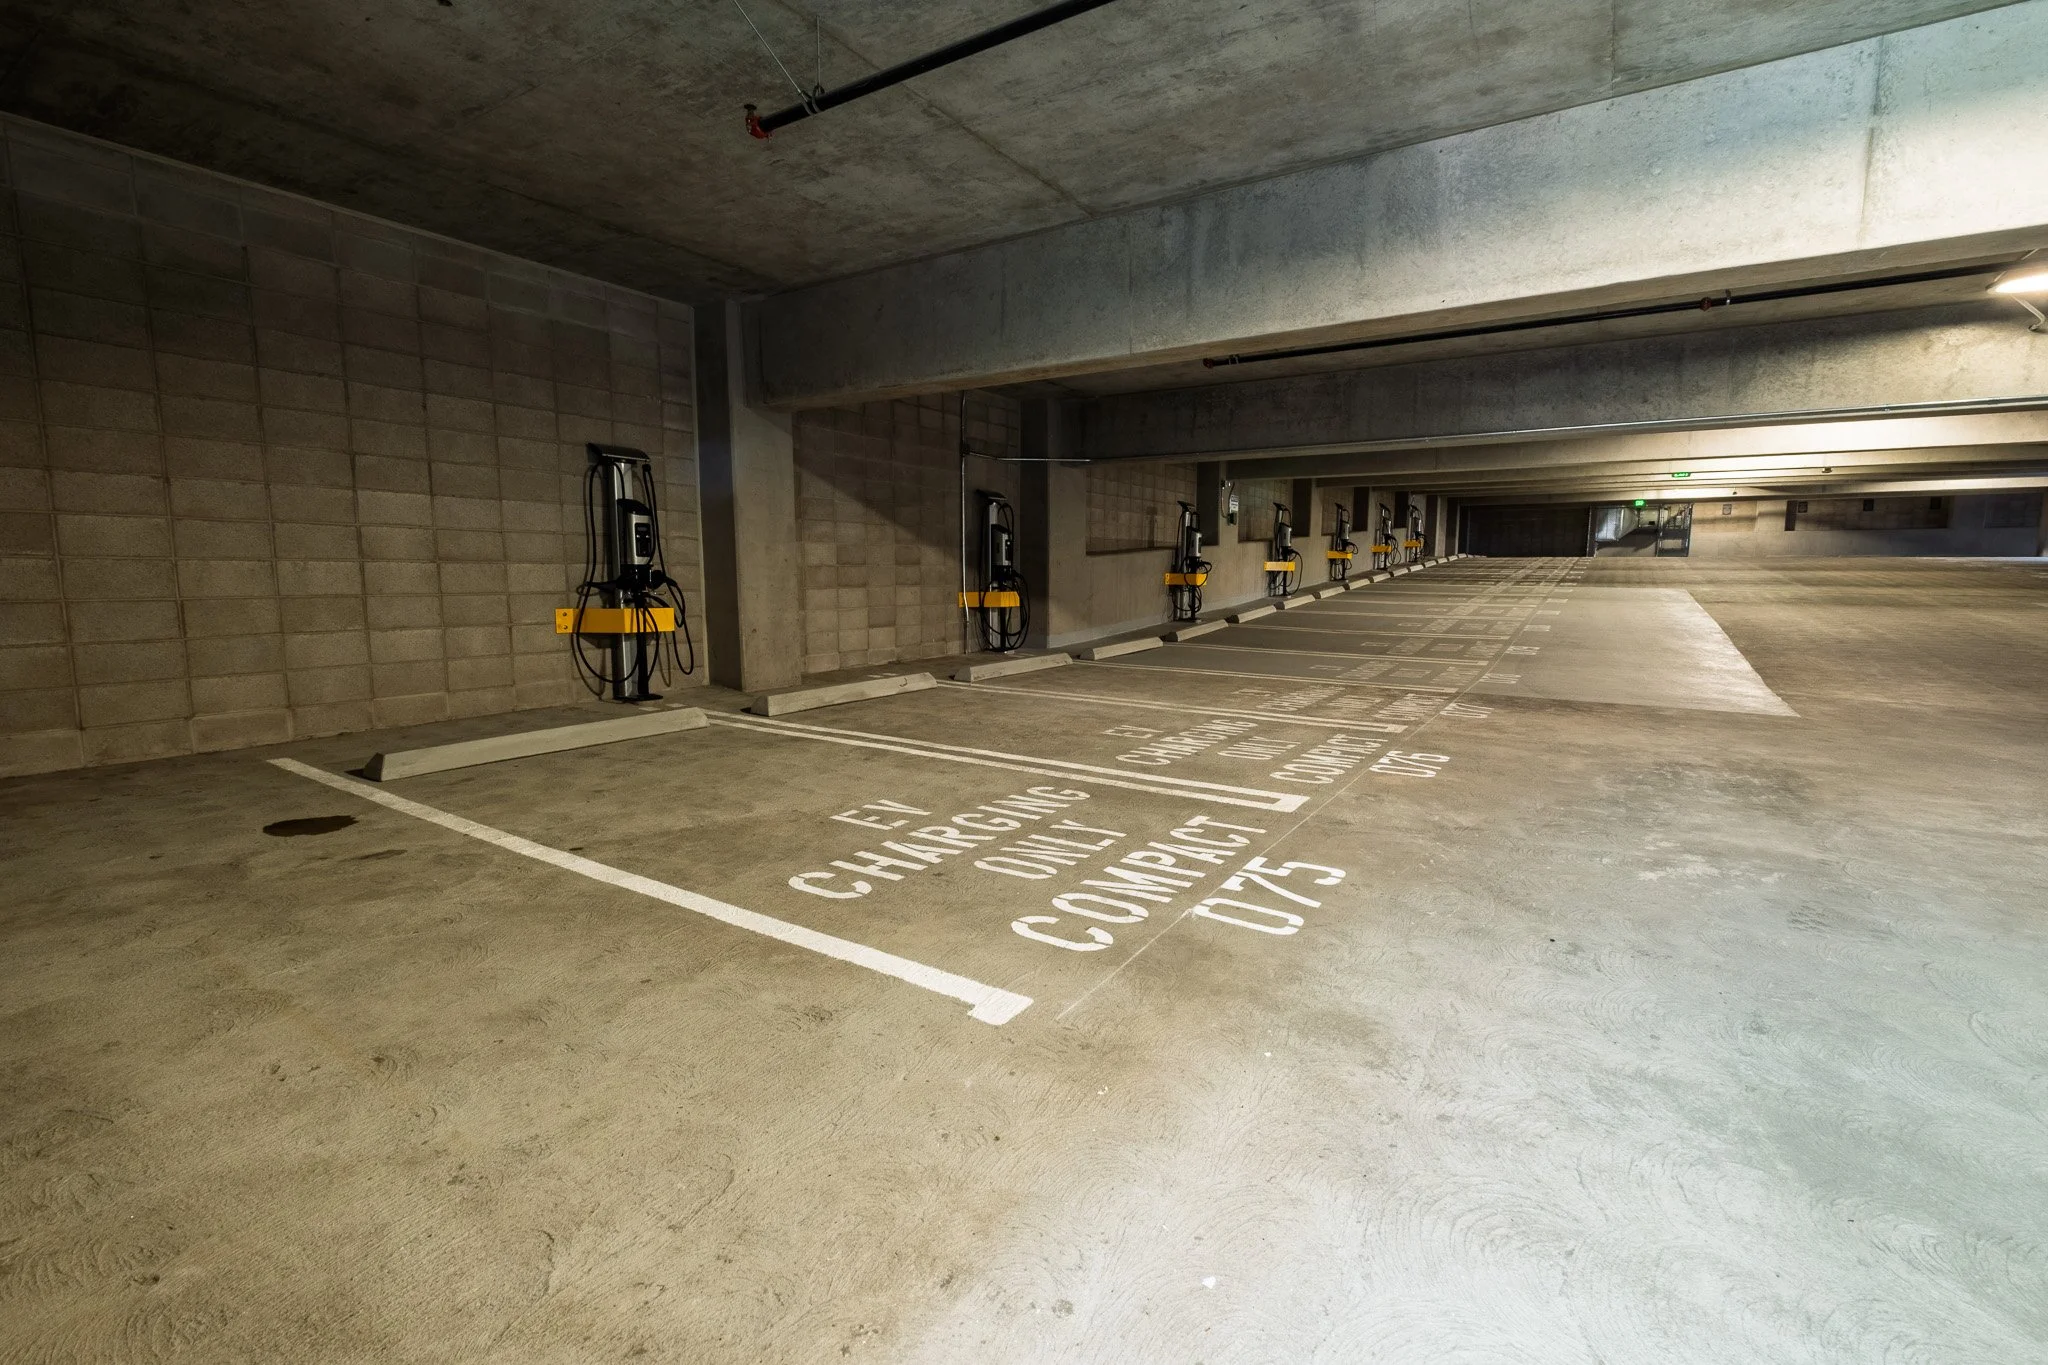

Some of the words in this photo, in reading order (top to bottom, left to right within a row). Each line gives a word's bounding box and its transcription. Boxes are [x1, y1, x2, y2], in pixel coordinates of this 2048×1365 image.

[1256, 685, 1346, 712] CHAR
[1101, 724, 1164, 739] EV
[1115, 719, 1259, 766] CHARGING
[1216, 735, 1302, 760] ONLY
[1269, 733, 1389, 784] COMPACT
[1368, 750, 1450, 778] 076
[829, 798, 932, 831] EV
[788, 786, 1091, 899] CHARGING
[973, 819, 1127, 880] ONLY
[1010, 815, 1267, 952] COMPACT
[1191, 856, 1347, 936] 075
